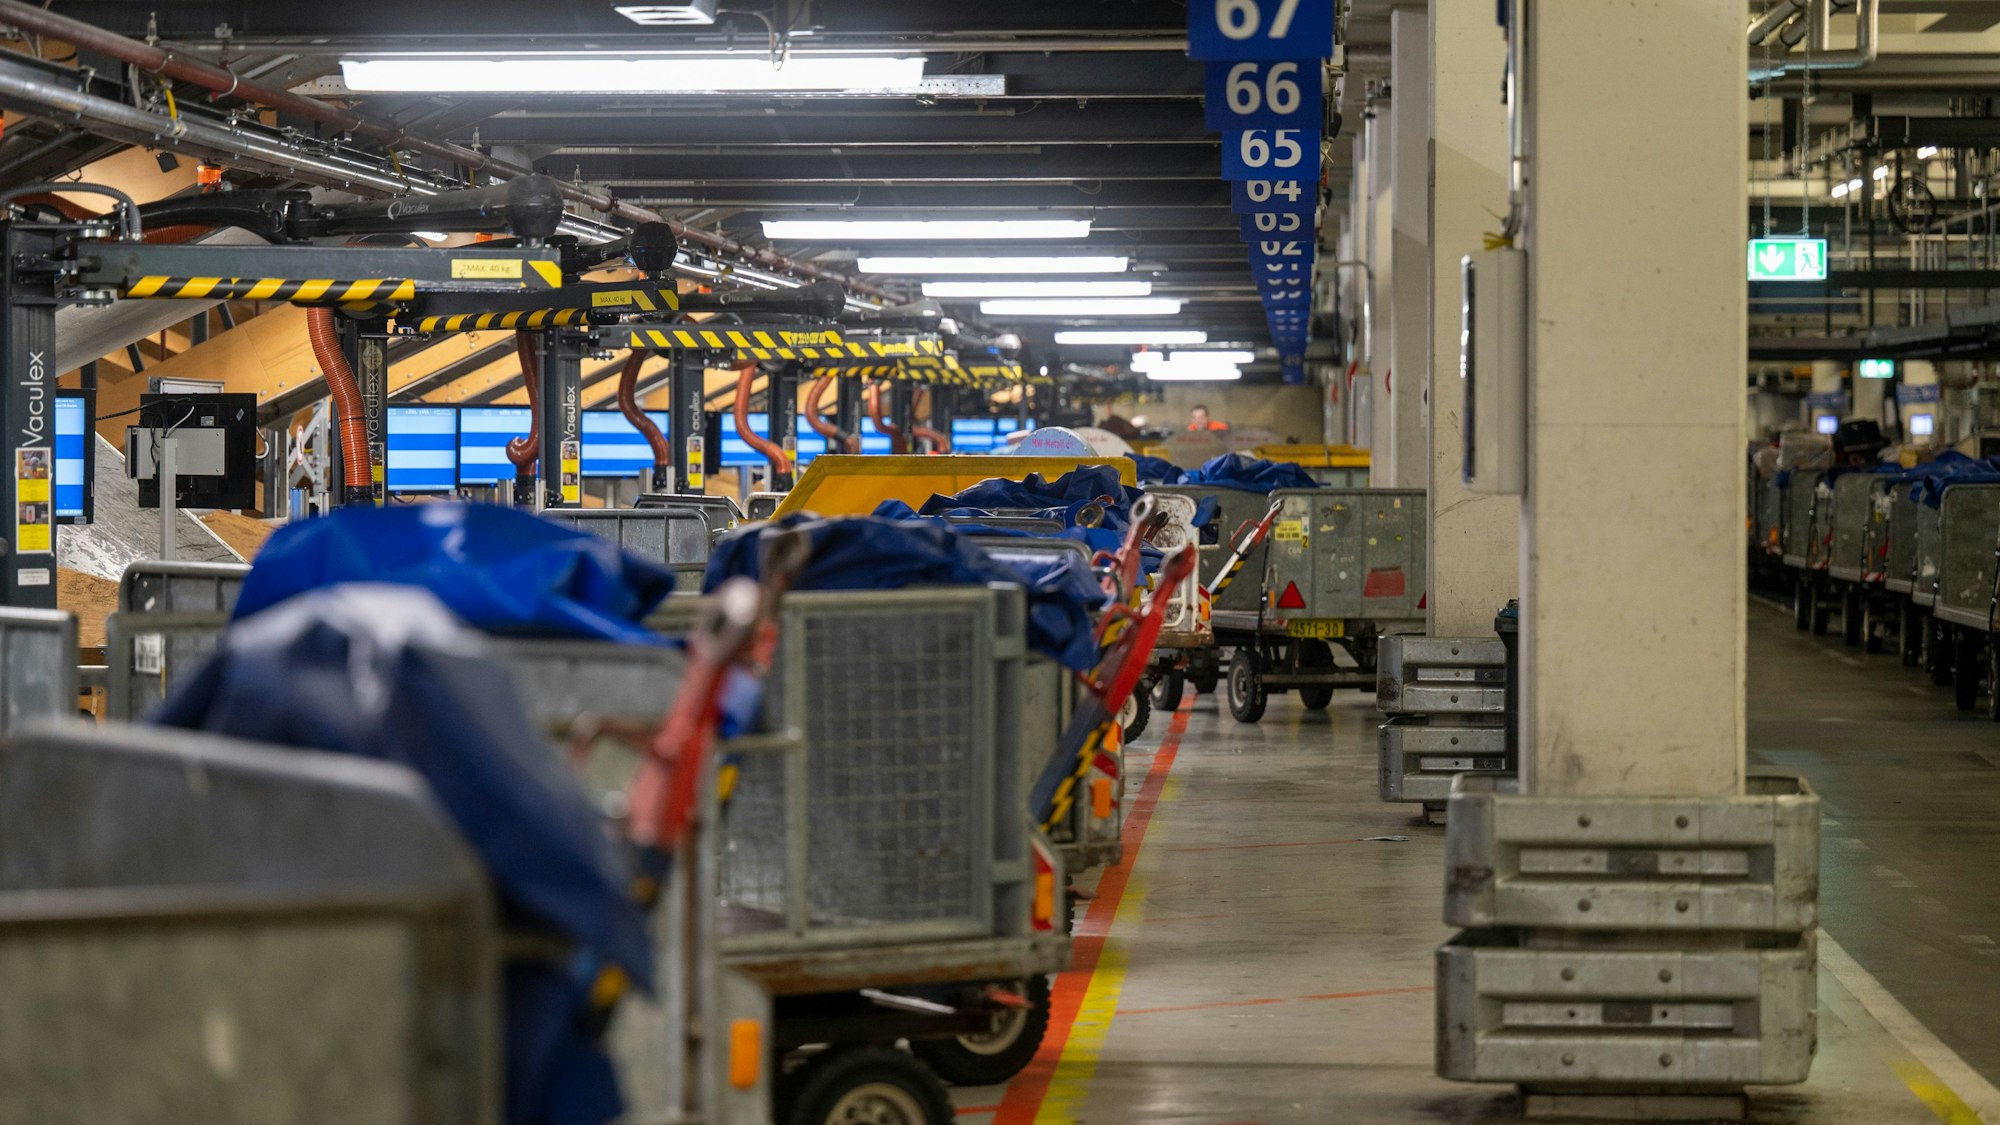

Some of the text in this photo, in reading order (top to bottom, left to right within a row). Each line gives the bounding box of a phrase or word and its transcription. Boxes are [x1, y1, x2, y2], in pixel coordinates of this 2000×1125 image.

[1215, 0, 1299, 40] 67
[1226, 62, 1300, 115] 66
[1240, 129, 1302, 168] 65
[489, 265, 500, 273] 40
[501, 265, 511, 274] kg
[20, 351, 44, 447] Vaculex
[363, 372, 379, 440] Vaculex
[562, 386, 576, 442] Vaculex
[1302, 535, 1308, 548] 2
